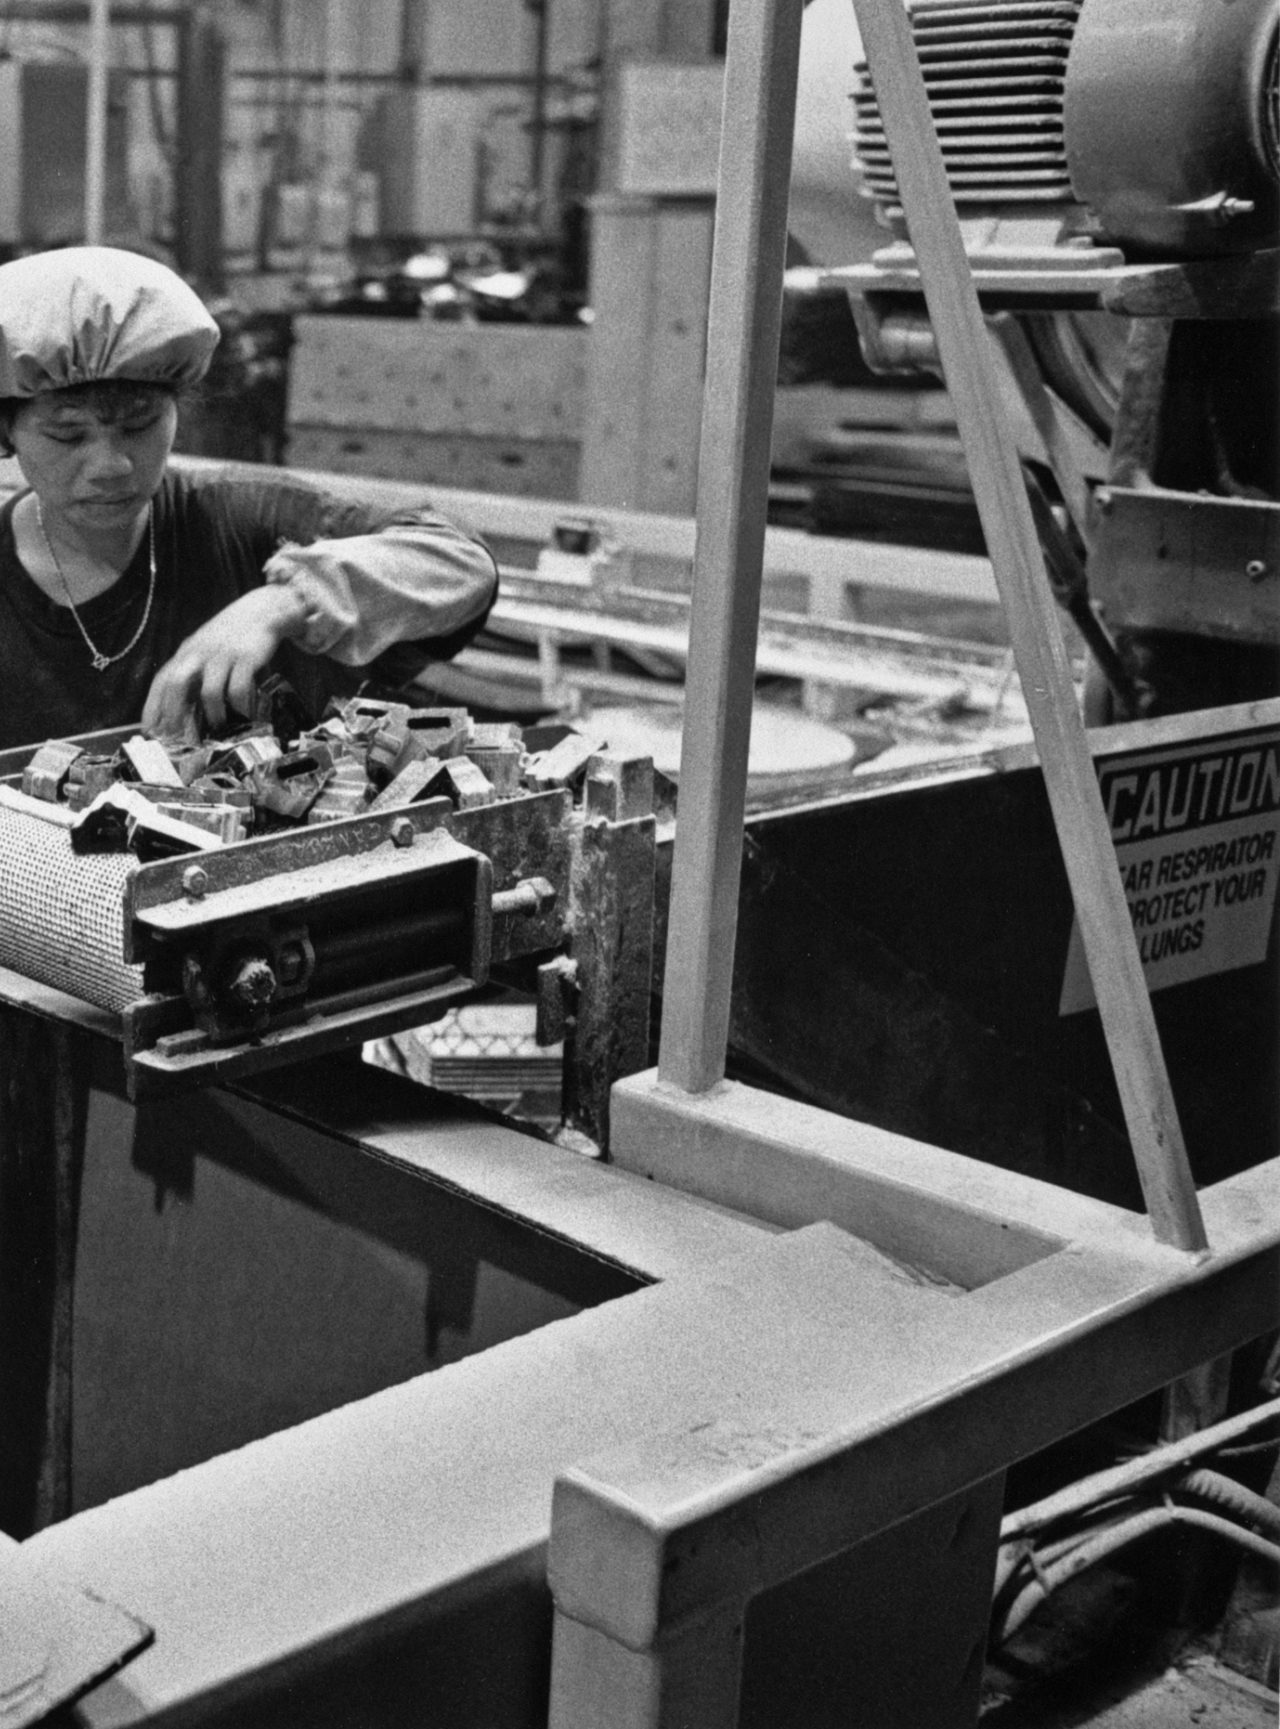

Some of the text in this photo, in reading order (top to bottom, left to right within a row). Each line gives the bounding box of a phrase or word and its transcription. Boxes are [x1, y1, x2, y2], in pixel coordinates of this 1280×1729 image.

[1108, 749, 1280, 840] CAUTION
[1120, 830, 1277, 892] AR RESPIRATOR
[1214, 868, 1266, 907] YOUR
[1140, 919, 1205, 964] LUNGS
